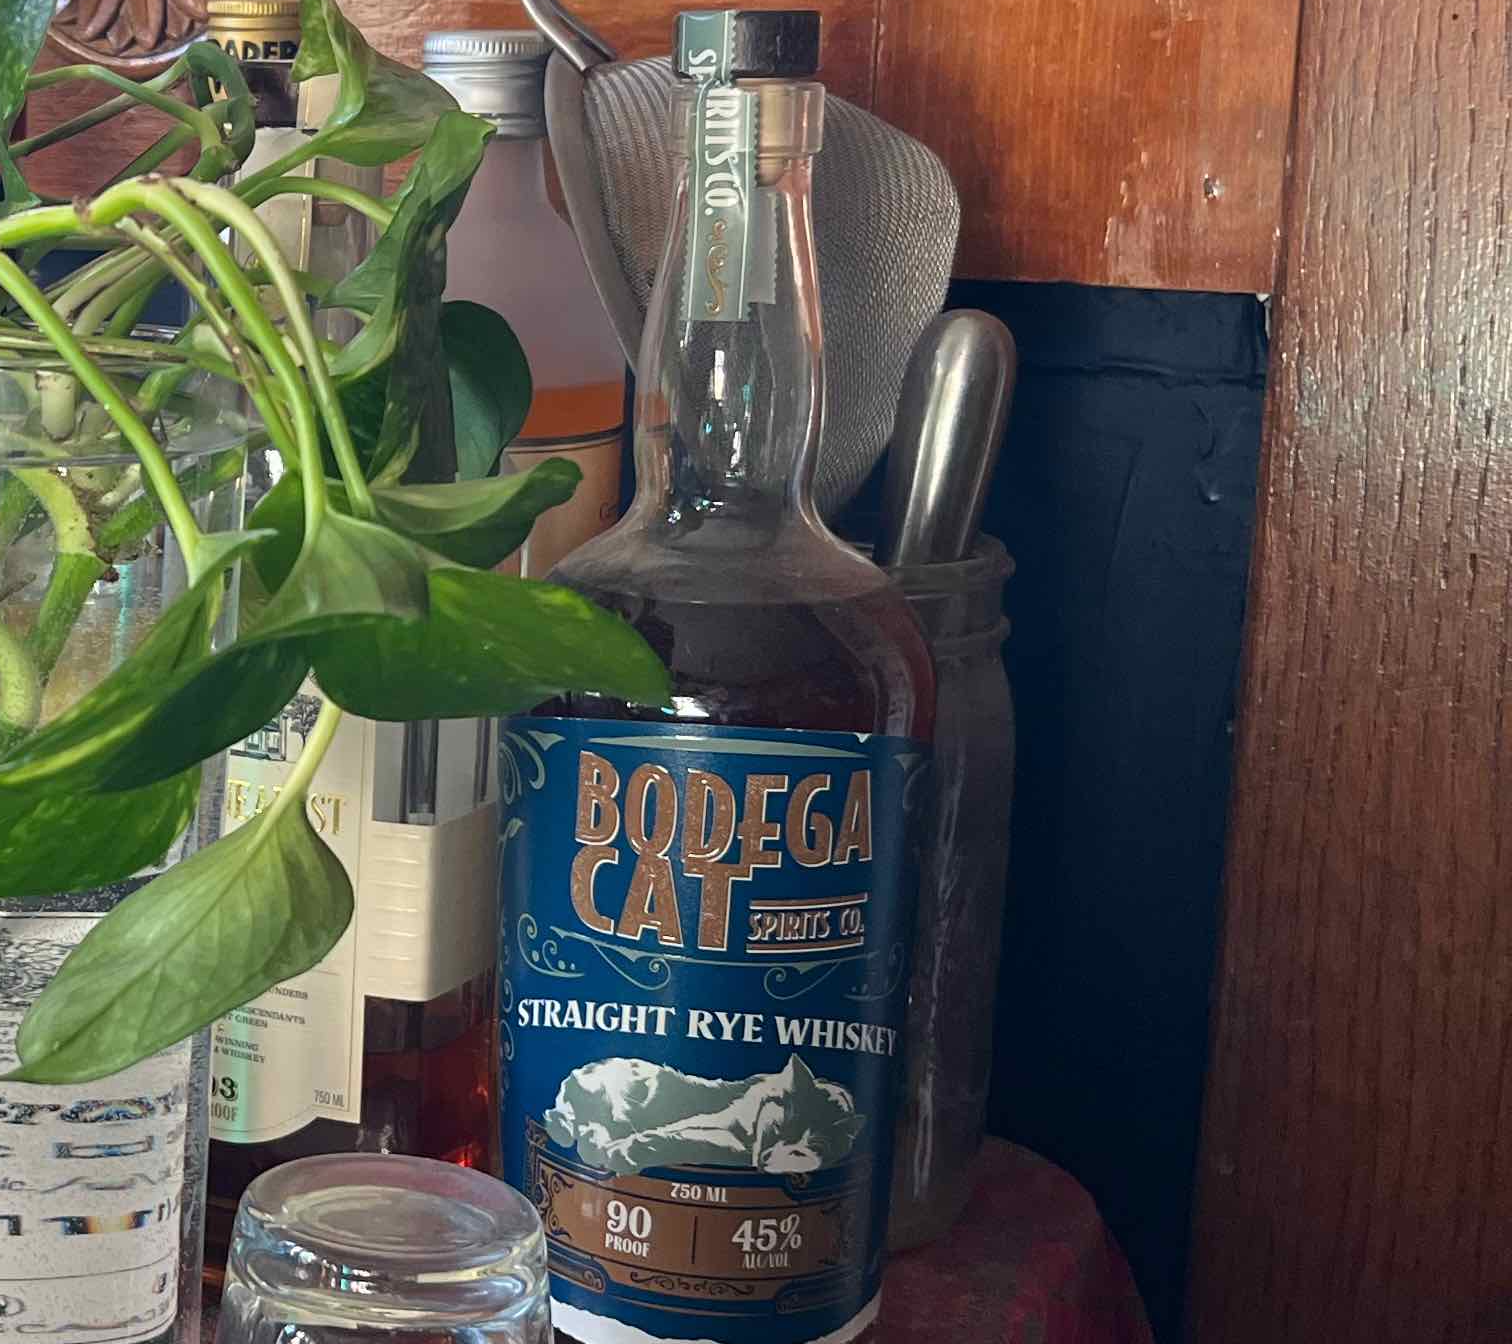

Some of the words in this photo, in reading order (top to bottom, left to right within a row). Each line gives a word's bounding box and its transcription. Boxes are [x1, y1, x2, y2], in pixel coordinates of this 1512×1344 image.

[575, 750, 873, 868] BODEGA
[569, 845, 753, 952] CAT
[747, 910, 831, 941] SPIRITS
[839, 907, 865, 937] CO.
[517, 998, 676, 1036] STRAIGHT
[688, 1008, 764, 1043] RYE
[774, 1016, 897, 1056] WHISKEY
[314, 1089, 332, 1105] 750
[670, 1182, 701, 1200] 750
[706, 1186, 728, 1203] ML
[605, 1199, 652, 1239] 90
[731, 1214, 802, 1252] 45%
[604, 1232, 650, 1257] PROOF
